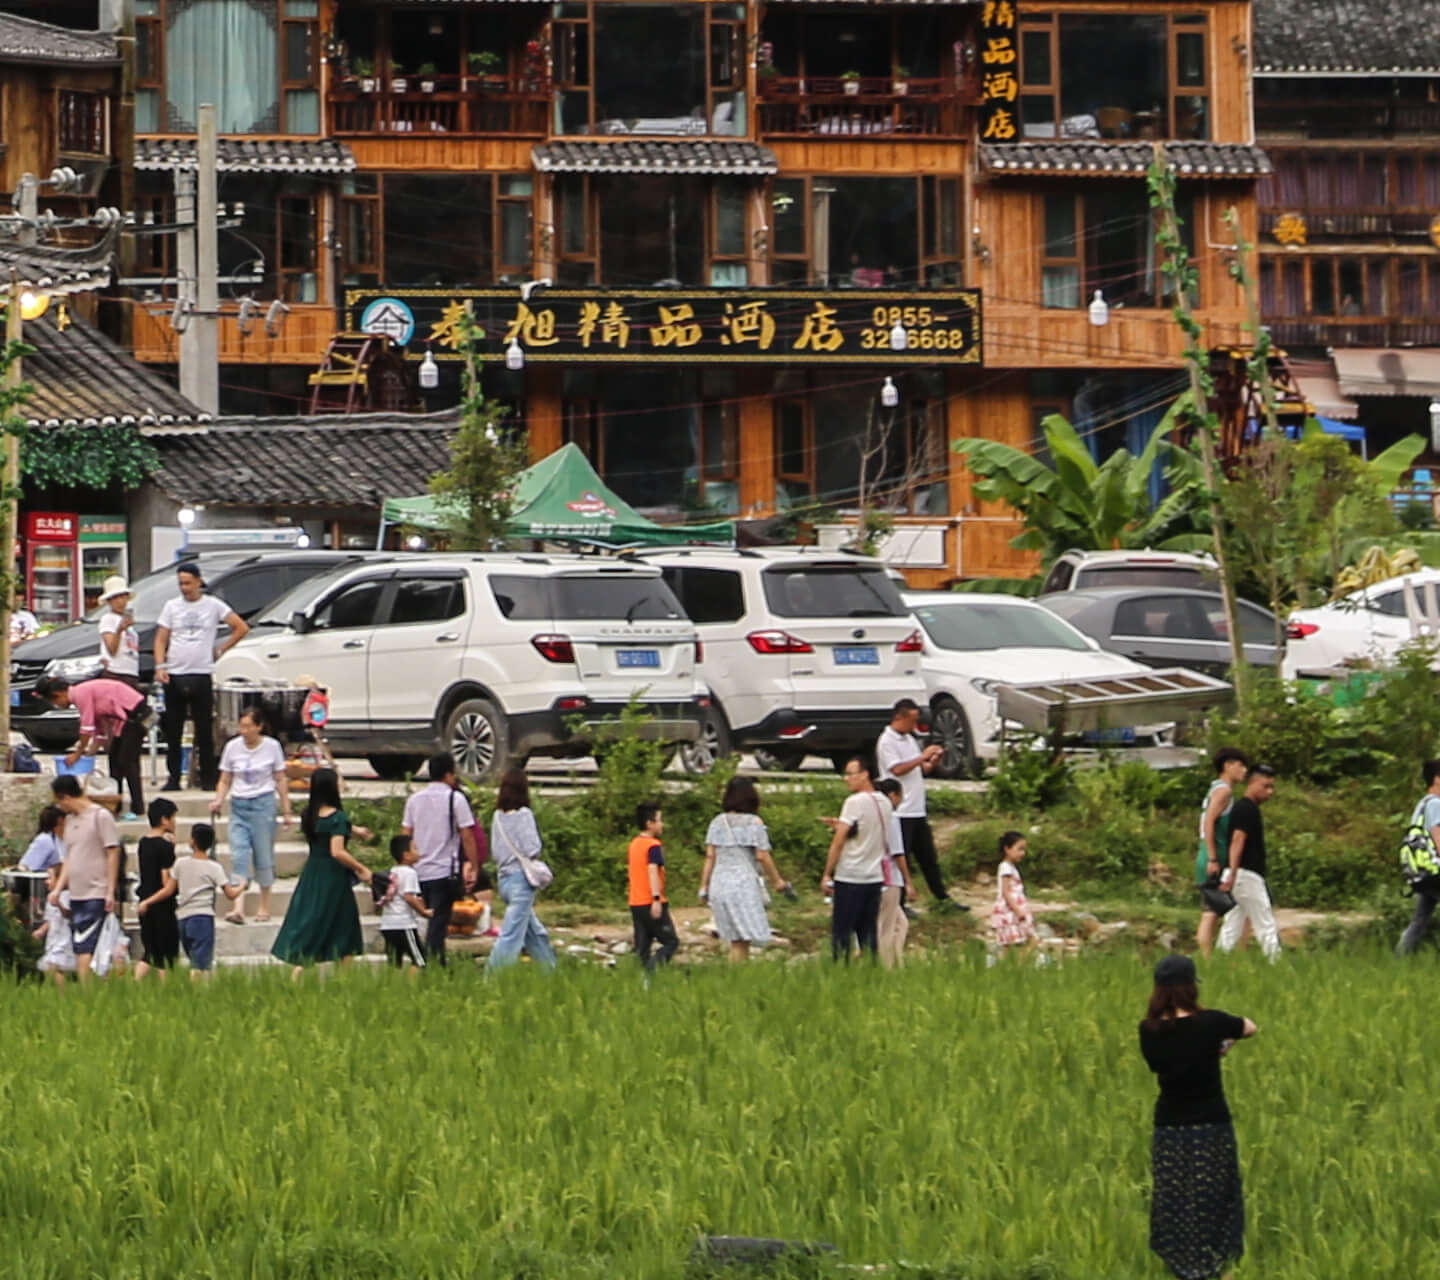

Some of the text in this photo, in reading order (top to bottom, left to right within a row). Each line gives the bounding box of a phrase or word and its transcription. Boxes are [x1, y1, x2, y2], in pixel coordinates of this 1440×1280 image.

[980, 0, 1019, 139] 精品酒店
[427, 298, 846, 351] 泰旭精品酒店
[859, 328, 963, 349] 326668
